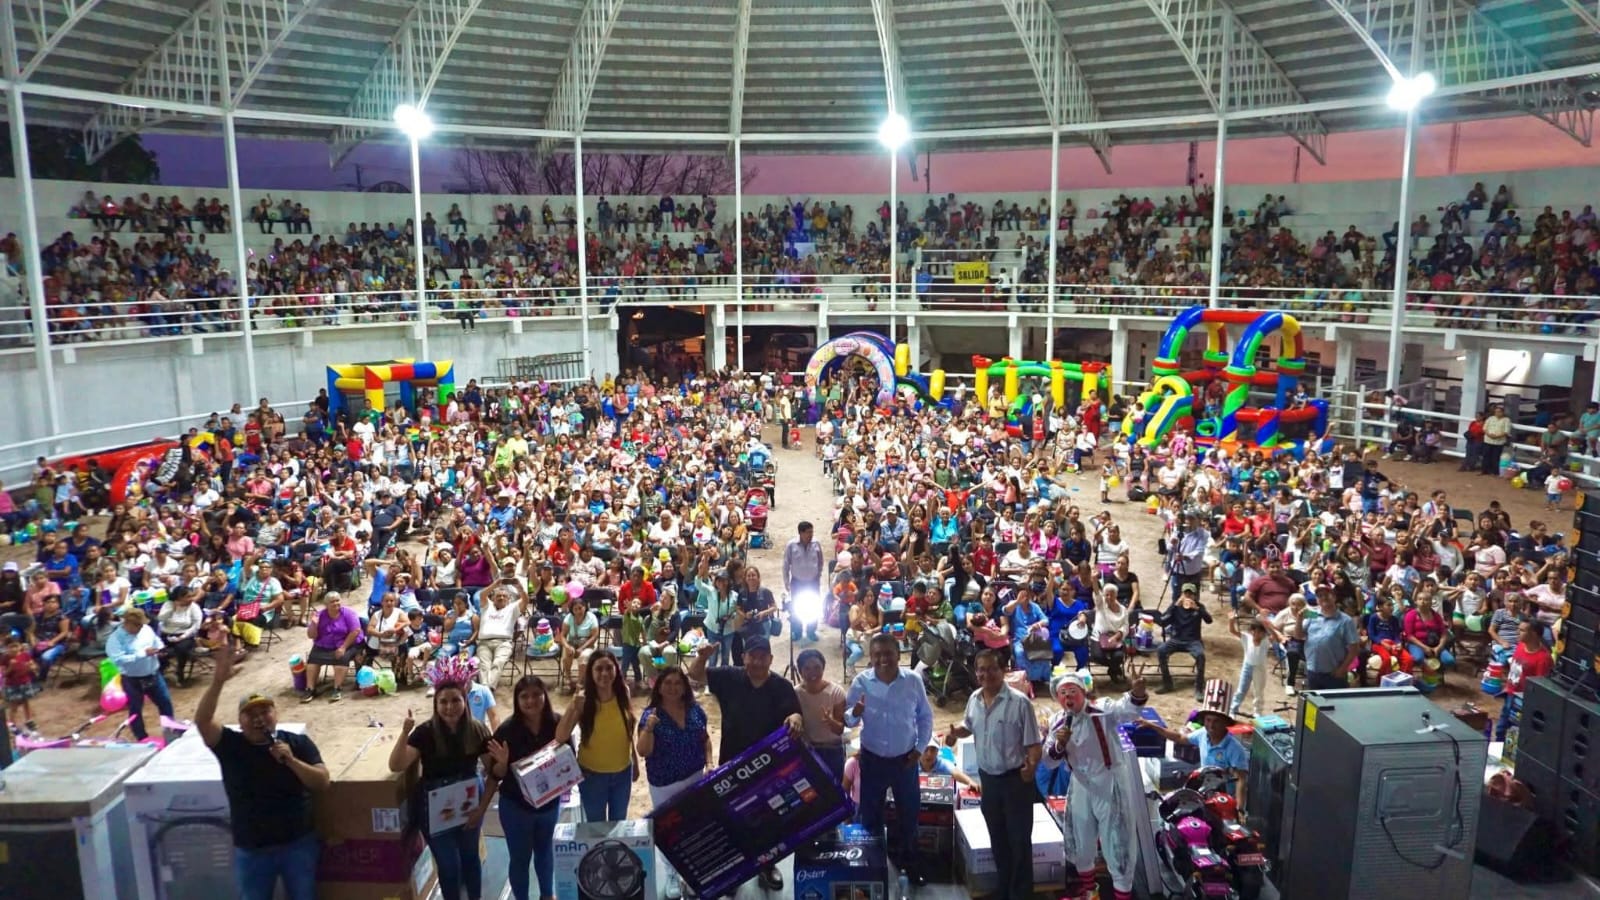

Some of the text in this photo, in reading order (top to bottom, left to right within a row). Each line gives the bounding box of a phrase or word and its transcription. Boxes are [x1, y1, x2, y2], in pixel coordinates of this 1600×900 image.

[958, 270, 985, 280] SALIDA
[736, 753, 772, 780] QLED
[817, 847, 863, 860] Oster
[797, 870, 827, 882] Oster
